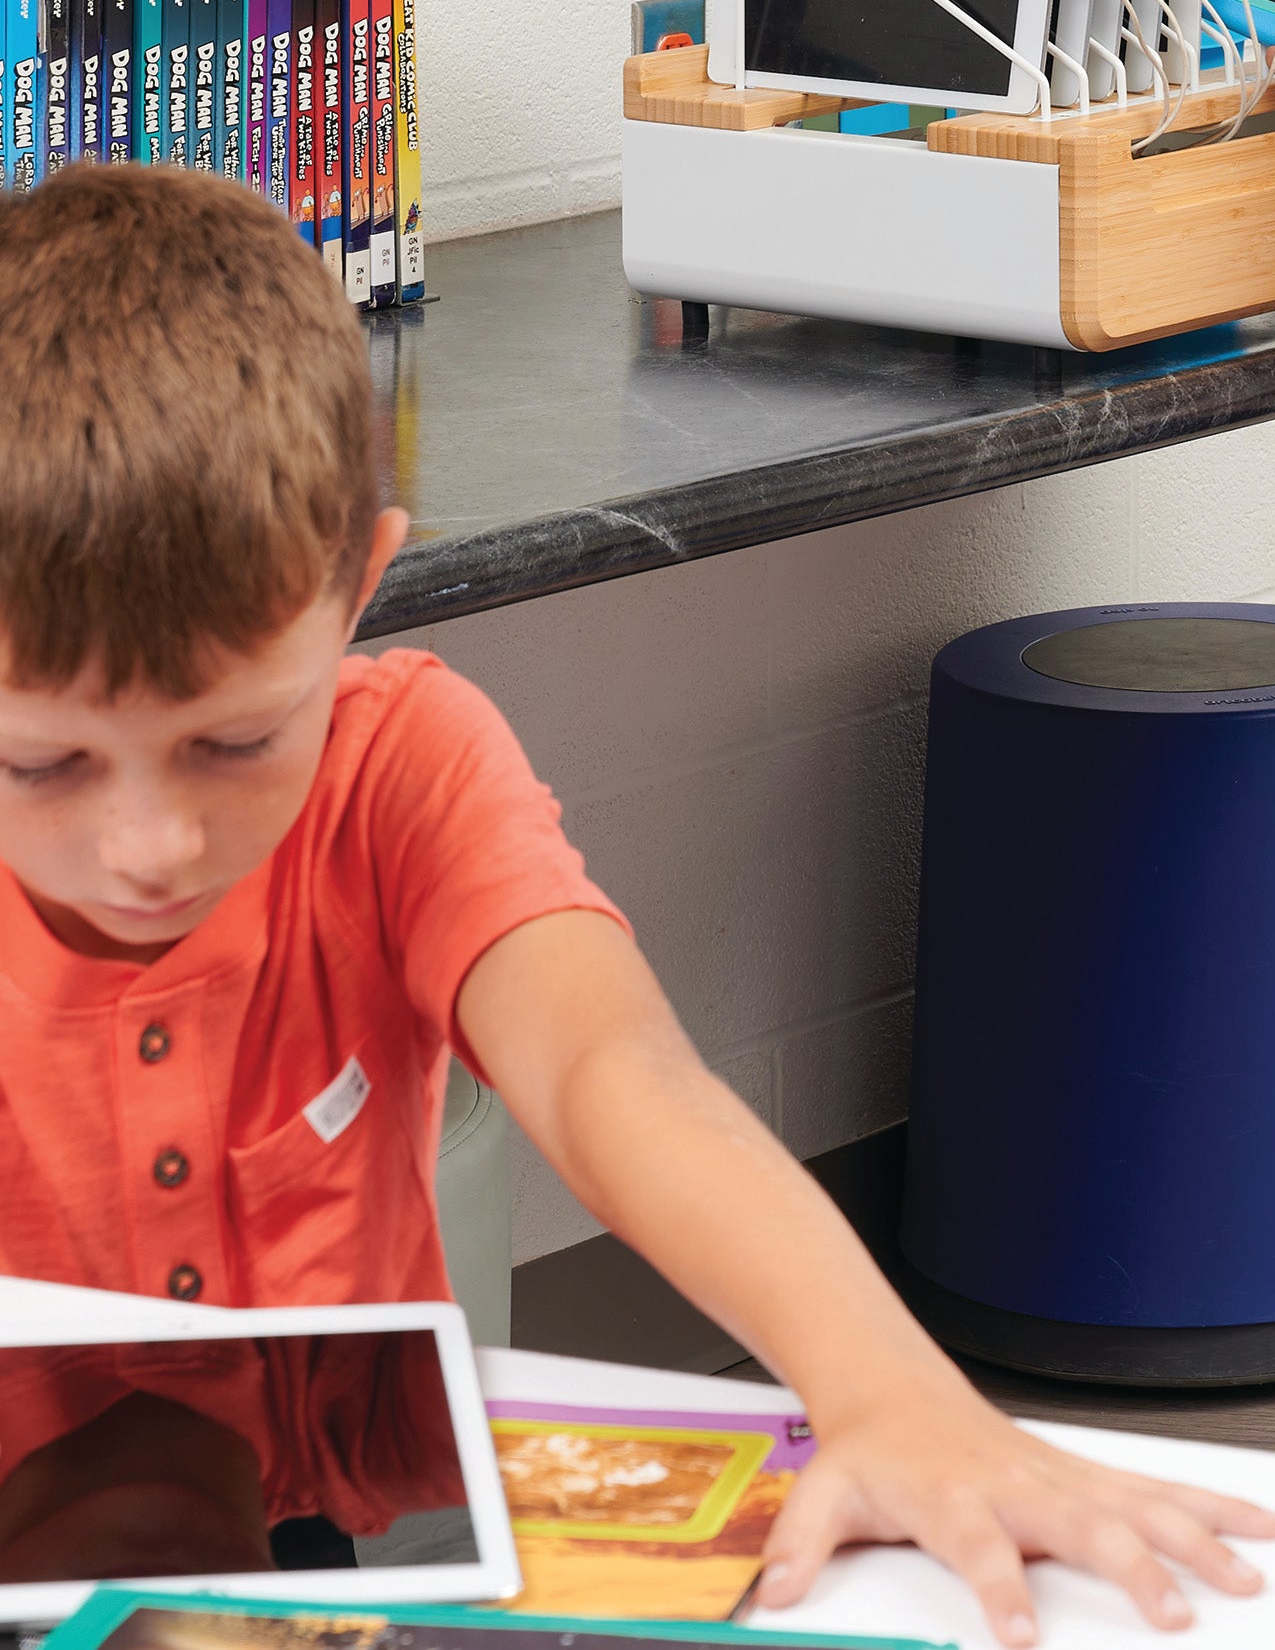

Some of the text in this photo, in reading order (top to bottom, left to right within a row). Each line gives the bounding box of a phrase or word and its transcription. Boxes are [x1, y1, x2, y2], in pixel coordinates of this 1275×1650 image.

[83, 54, 98, 99] DOG
[111, 49, 130, 138] DOG MAN
[145, 44, 161, 89] DOG
[170, 44, 188, 133] DOG MAN
[198, 41, 214, 130] DOG MAN
[226, 38, 241, 126] DOG MAN
[251, 35, 265, 122] DOG MAN
[273, 32, 290, 118] DOG MAN
[298, 25, 314, 112] DOG MAN
[324, 22, 339, 108] DOG MAN
[353, 18, 368, 105] DOG MAN
[375, 15, 392, 102] DOG MAN
[15, 58, 34, 149] DOG MAN
[49, 57, 67, 148] DOG MAN
[84, 103, 97, 145] MAN
[145, 92, 160, 134] MAN
[408, 237, 418, 245] GN
